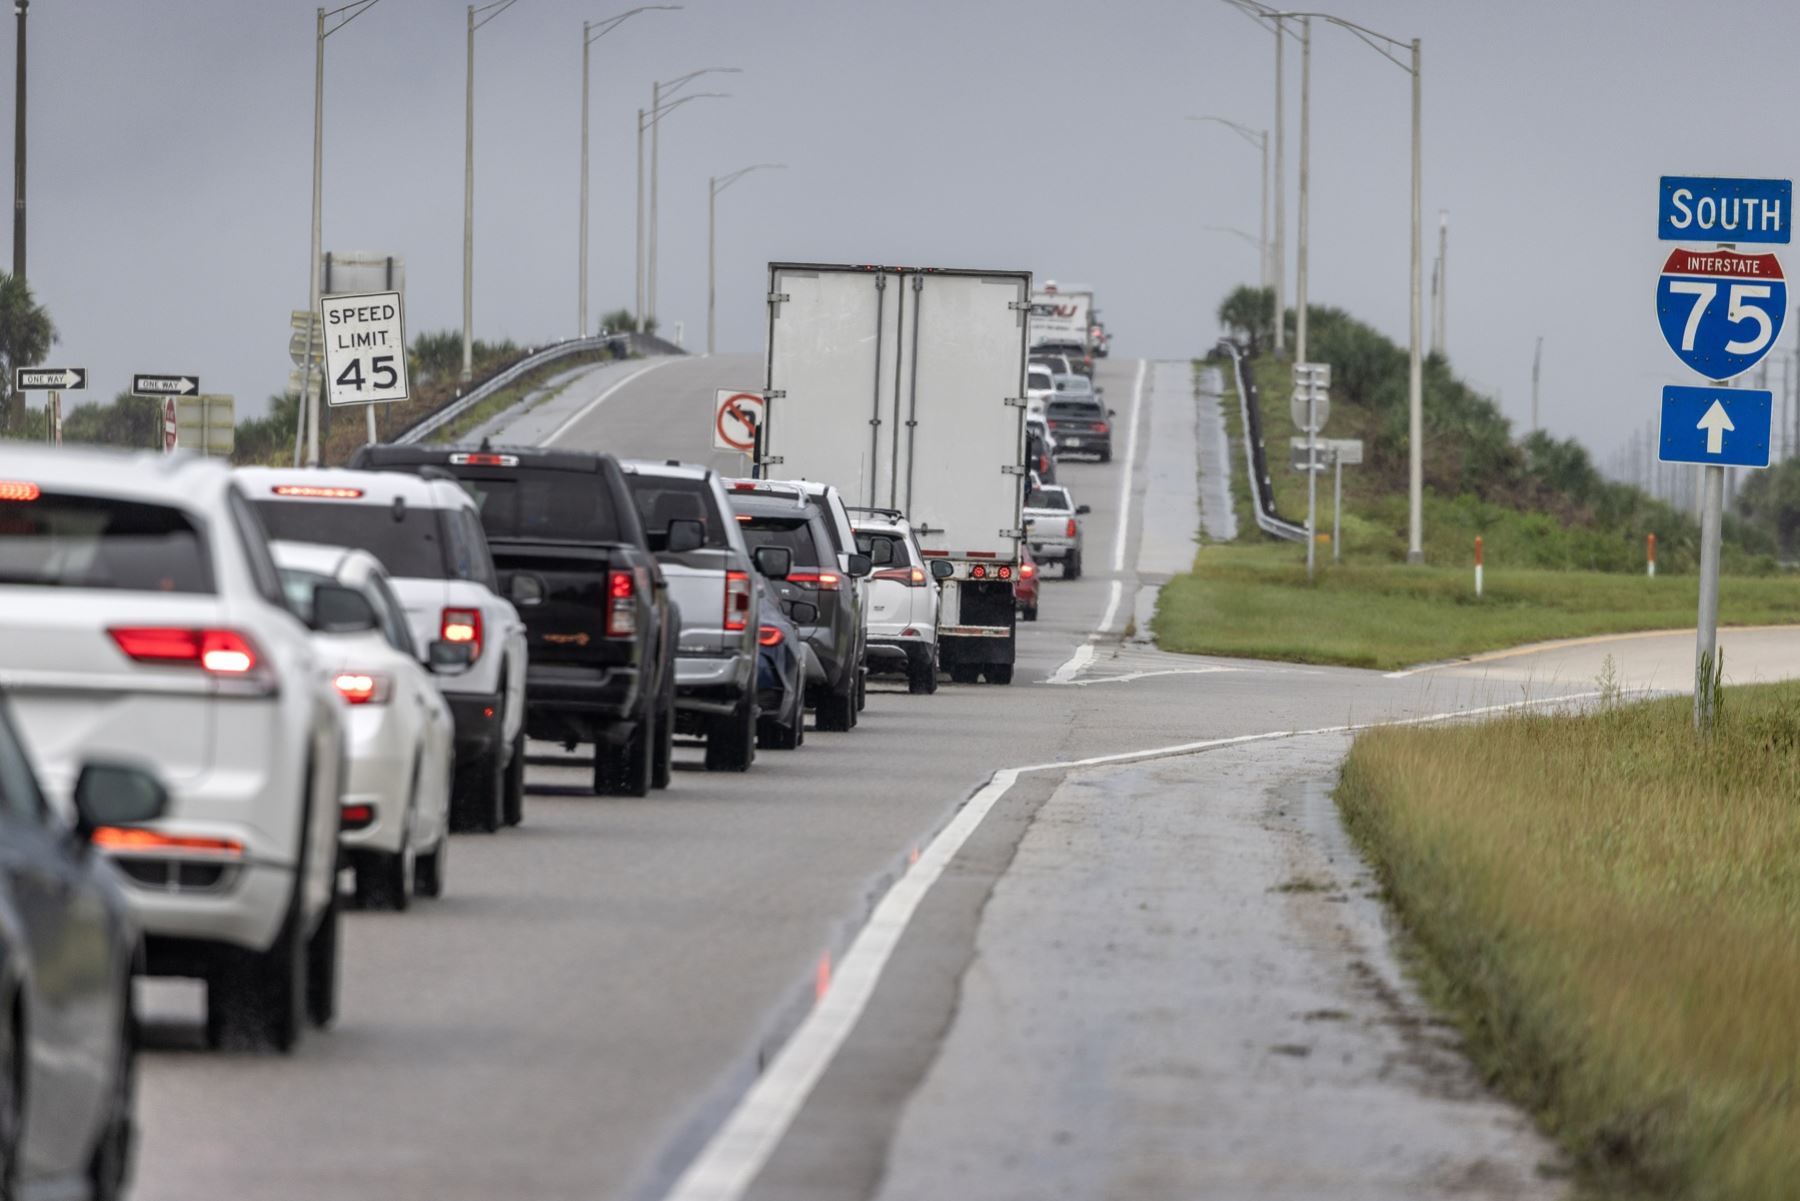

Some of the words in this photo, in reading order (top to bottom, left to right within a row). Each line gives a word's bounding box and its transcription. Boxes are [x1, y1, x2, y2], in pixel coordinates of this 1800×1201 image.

[1670, 188, 1780, 231] SOUTH
[1687, 256, 1760, 274] INTERSTATE
[329, 304, 395, 325] SPEED
[1669, 281, 1773, 354] 75
[338, 330, 389, 349] LIMIT
[27, 374, 43, 385] ONE
[47, 374, 64, 384] WAY
[336, 355, 398, 391] 45
[161, 382, 178, 391] WAY
